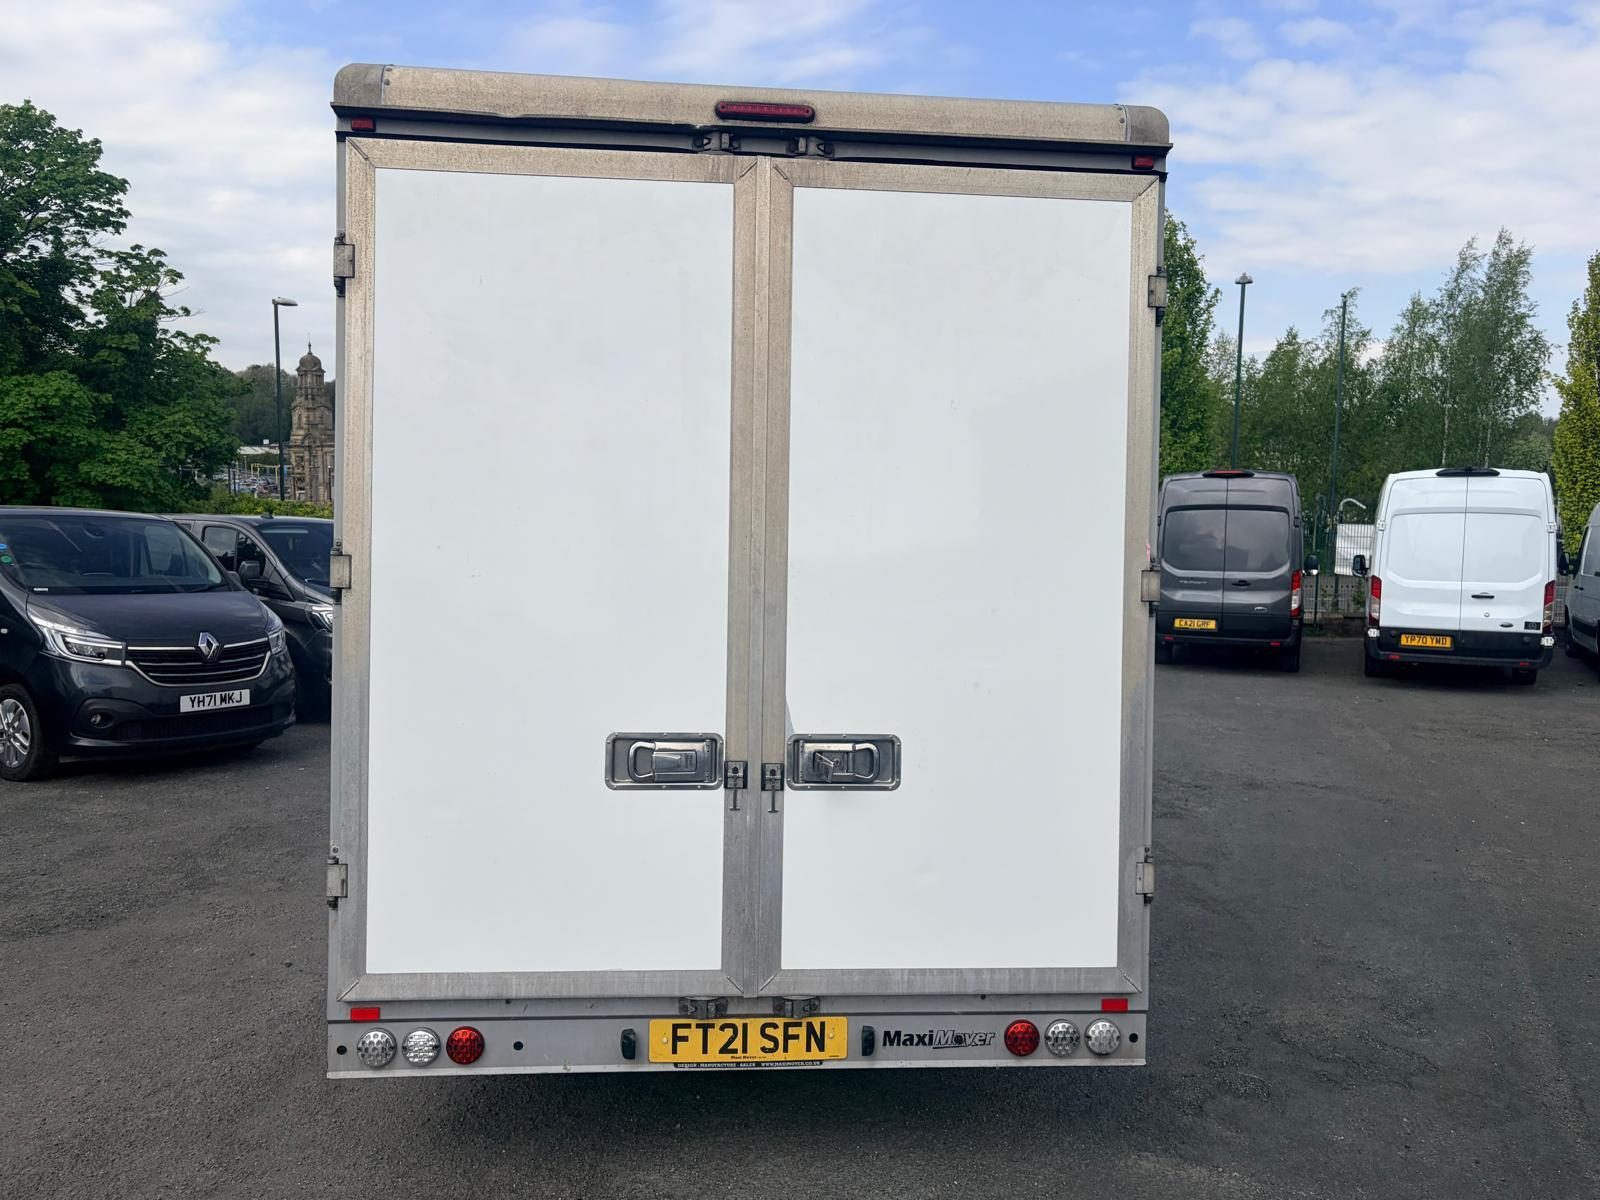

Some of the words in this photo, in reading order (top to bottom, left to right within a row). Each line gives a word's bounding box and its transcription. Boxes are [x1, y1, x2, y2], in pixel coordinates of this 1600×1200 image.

[1405, 635, 1428, 645] YP70
[189, 694, 217, 708] YH71
[220, 691, 243, 705] MKJ
[671, 1022, 748, 1055] FT21
[760, 1021, 826, 1053] SFN
